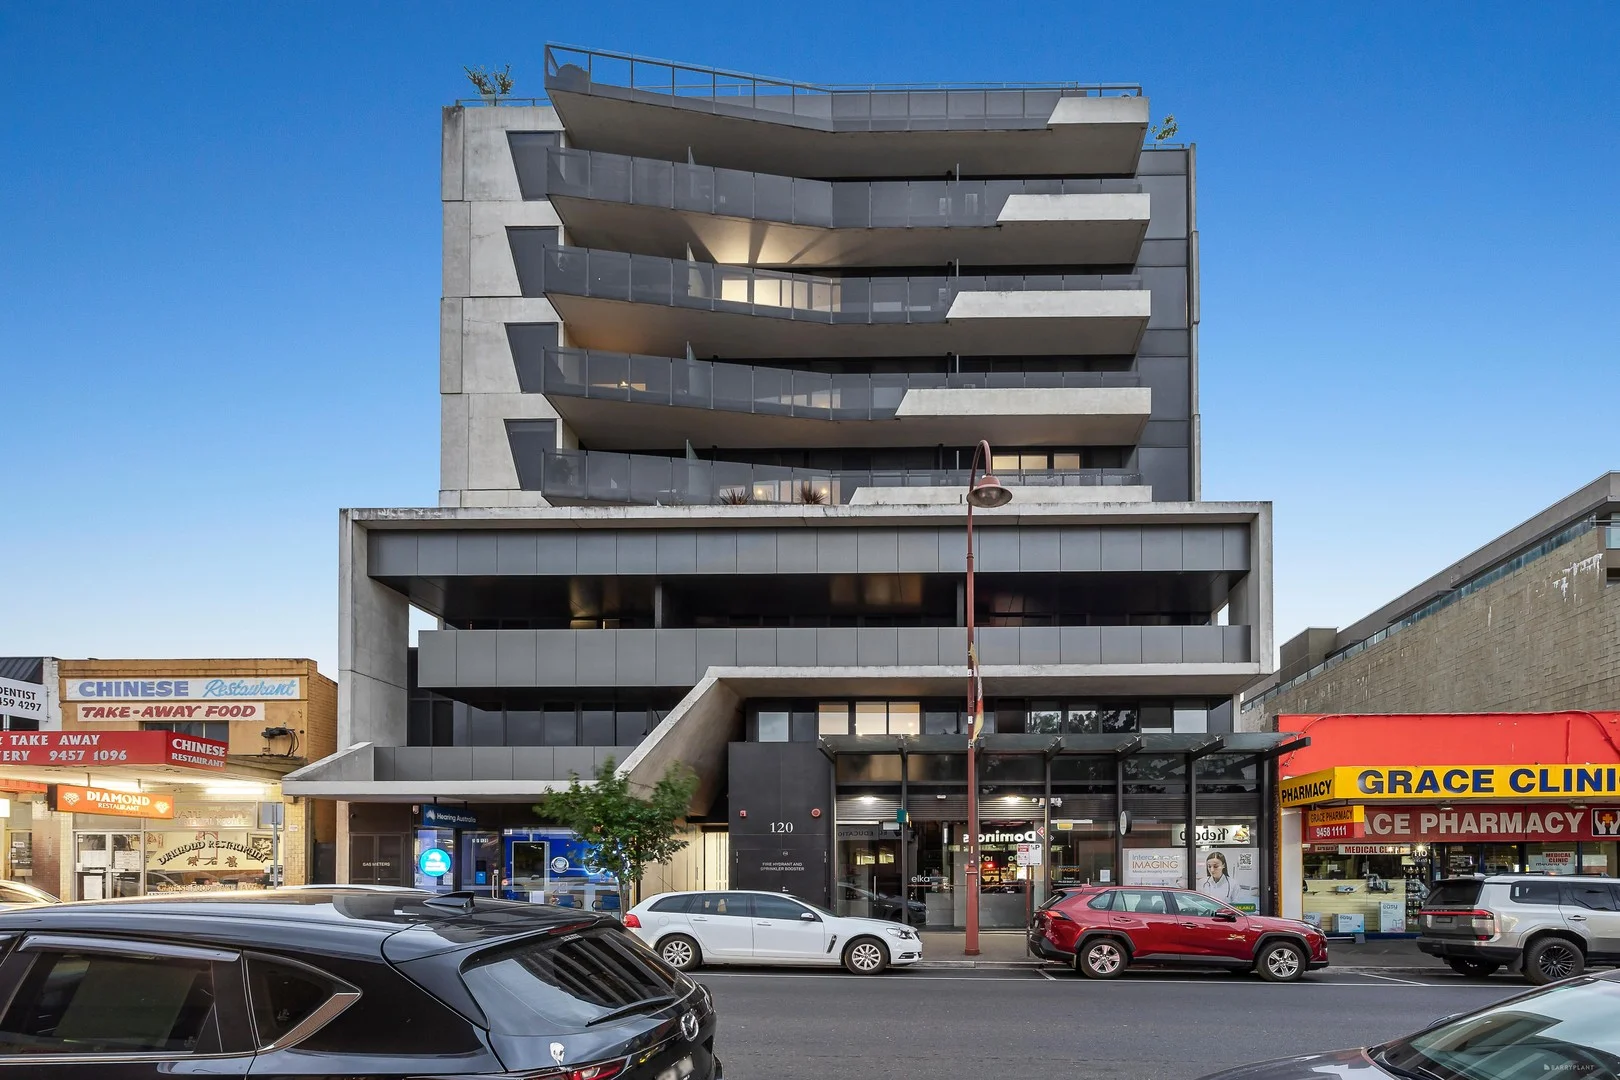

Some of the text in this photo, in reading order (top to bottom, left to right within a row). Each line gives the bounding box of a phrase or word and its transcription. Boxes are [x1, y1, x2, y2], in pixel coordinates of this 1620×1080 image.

[79, 679, 296, 698] CHINESE Restaurant
[18, 700, 42, 712] 4297
[205, 705, 256, 718] FOOD
[10, 735, 49, 746] TAKE
[58, 734, 100, 746] AWAY
[172, 738, 226, 757] CHINESE
[0, 749, 127, 761] ERY 9457 1096
[171, 752, 225, 768] RESTAURANT
[1357, 768, 1620, 794] GRACE CLINI
[1281, 779, 1332, 803] PHARMACY
[86, 791, 151, 806] DIAMOND
[98, 803, 140, 811] RESTAURANT
[436, 812, 477, 823] Hearing Australia
[1326, 809, 1353, 822] PHARMACY
[770, 822, 794, 833] 120
[1420, 812, 1584, 834] PHARMACY
[1316, 825, 1347, 837] 9458 1111
[157, 839, 206, 865] DIAMOND
[1344, 845, 1378, 854] MEDICAL
[1412, 849, 1428, 857] 110
[1132, 860, 1178, 869] IMAGING
[911, 875, 931, 883] elka
